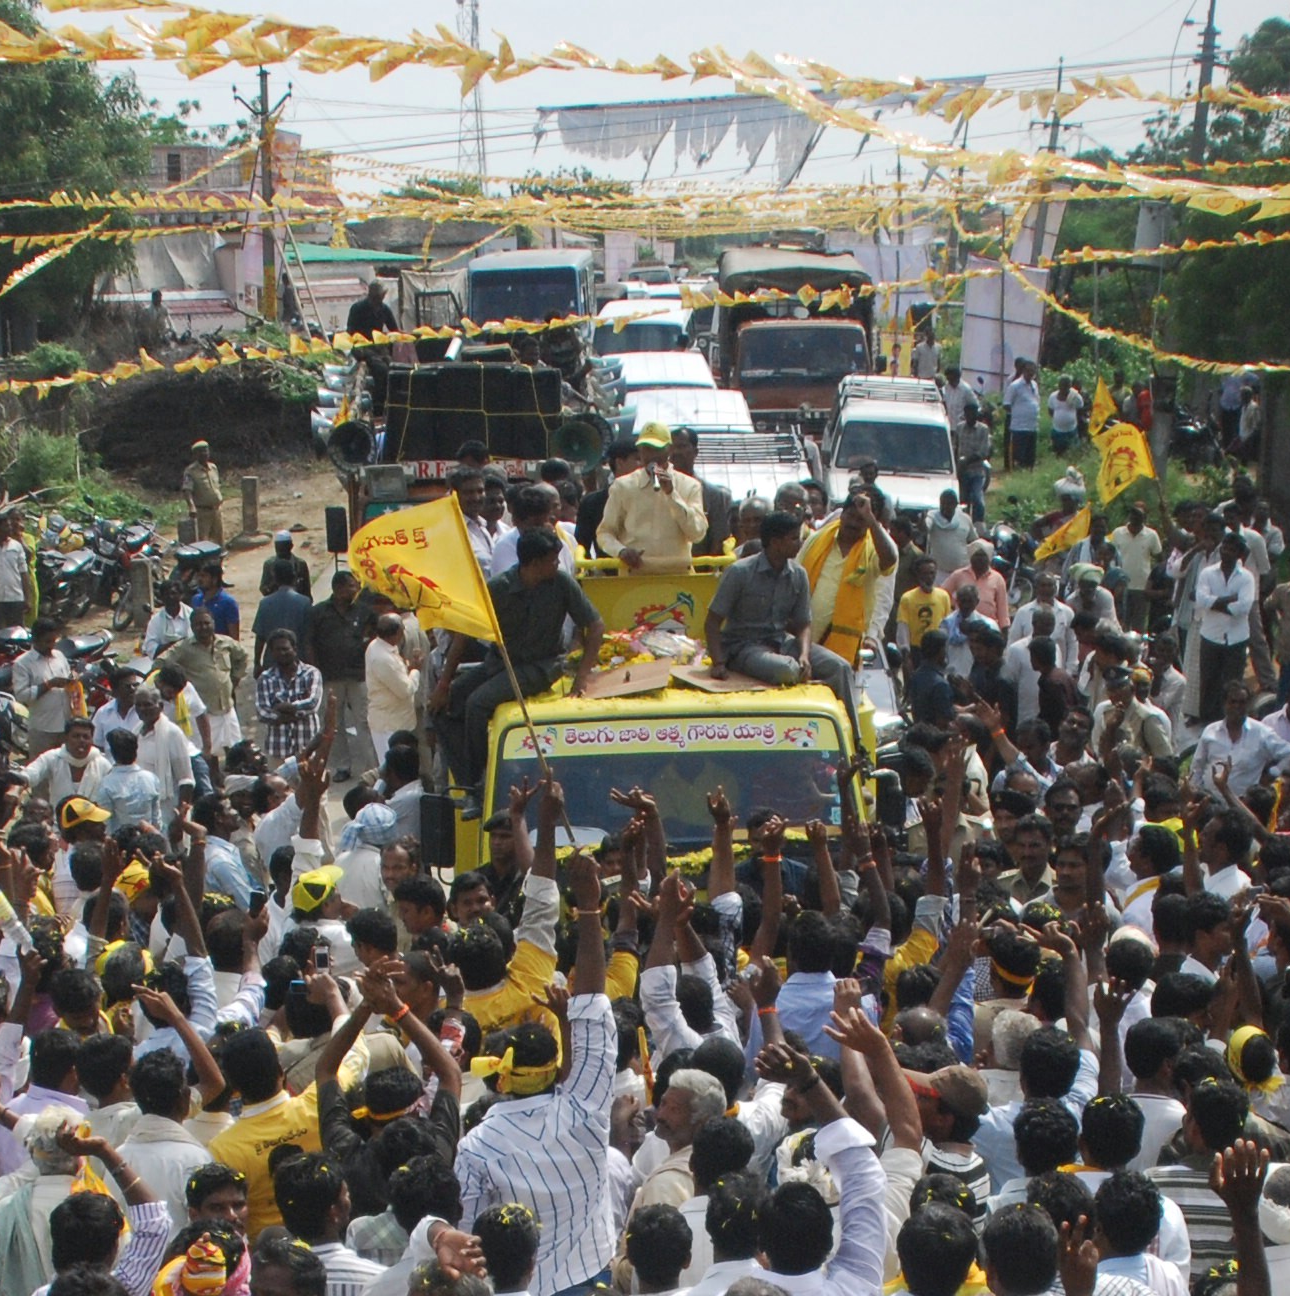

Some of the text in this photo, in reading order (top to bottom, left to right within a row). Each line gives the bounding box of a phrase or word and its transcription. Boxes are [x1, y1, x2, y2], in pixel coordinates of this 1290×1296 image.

[564, 723, 775, 748] తెలుగు జాతి ఆత్మ గౌరవ యాత్ర
